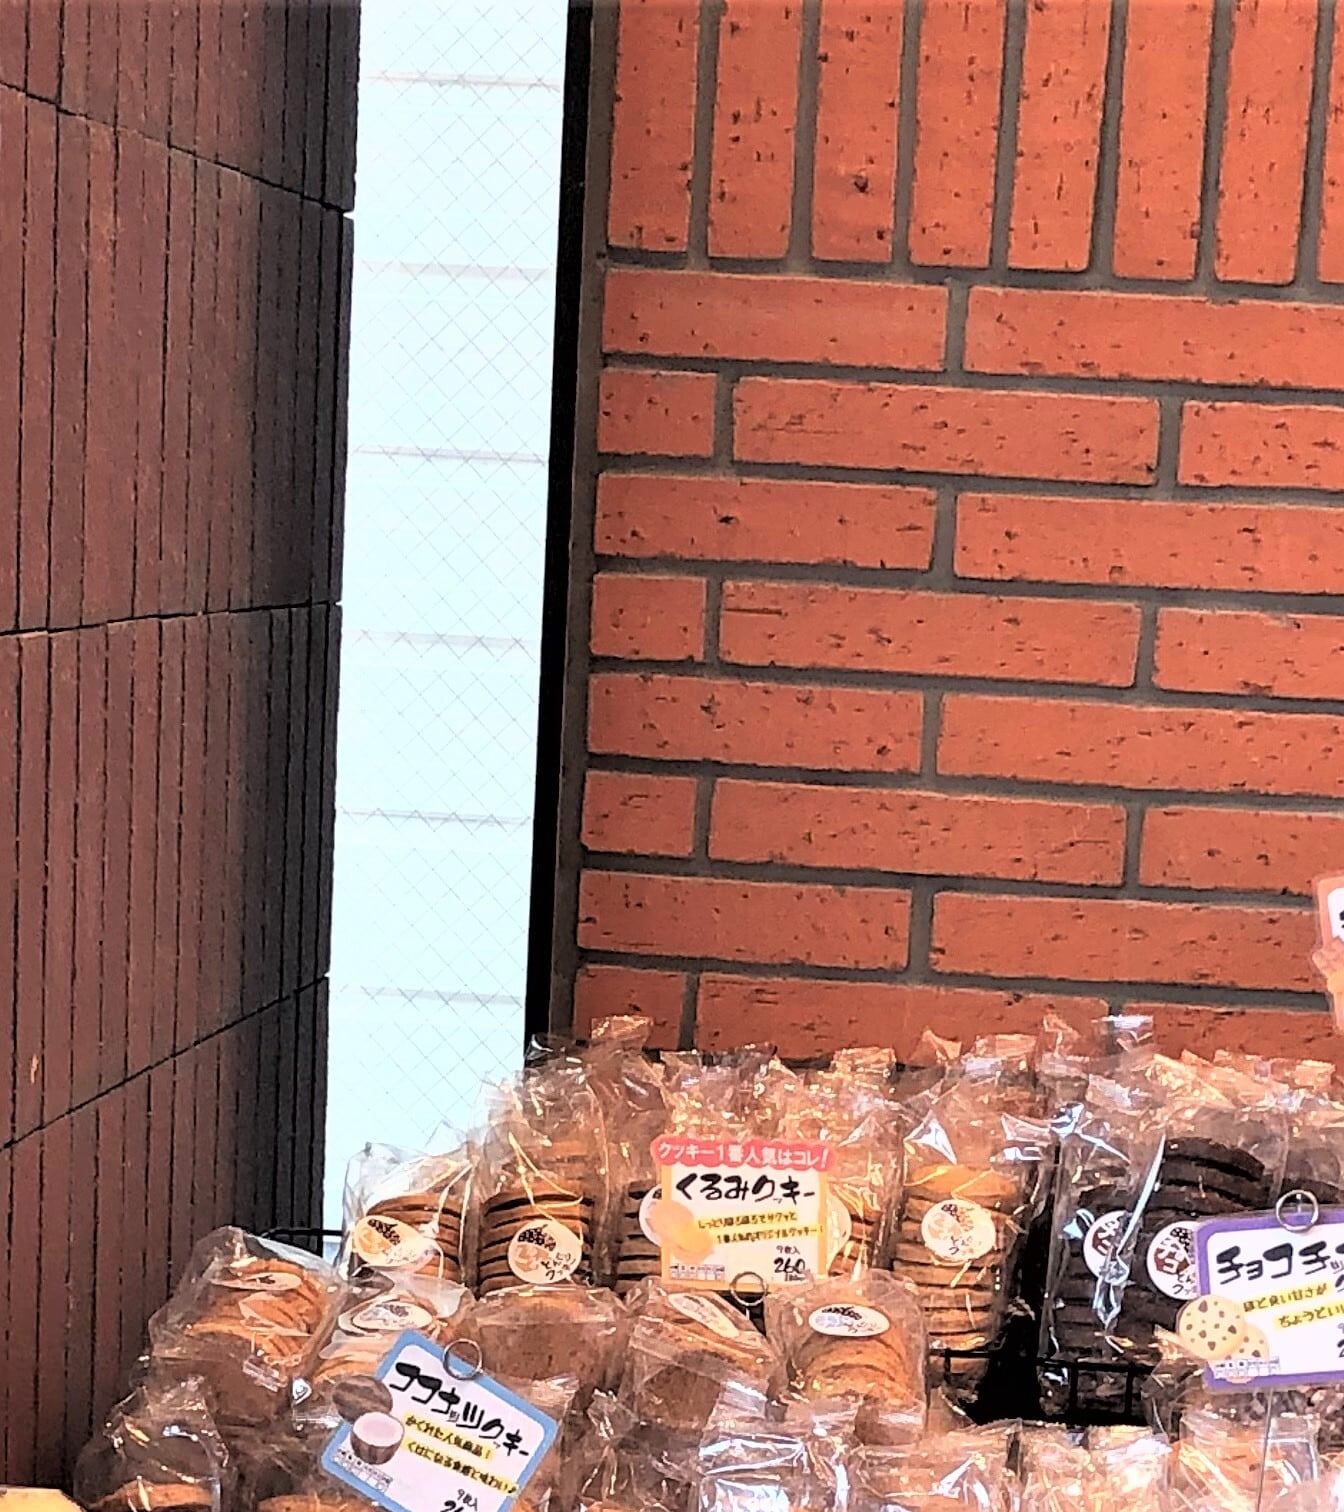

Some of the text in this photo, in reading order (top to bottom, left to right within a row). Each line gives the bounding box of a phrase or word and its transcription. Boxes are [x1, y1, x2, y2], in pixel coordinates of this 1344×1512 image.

[659, 1143, 828, 1168] クッキー1番人気はコレ!
[676, 1173, 815, 1204] くるみクッキー
